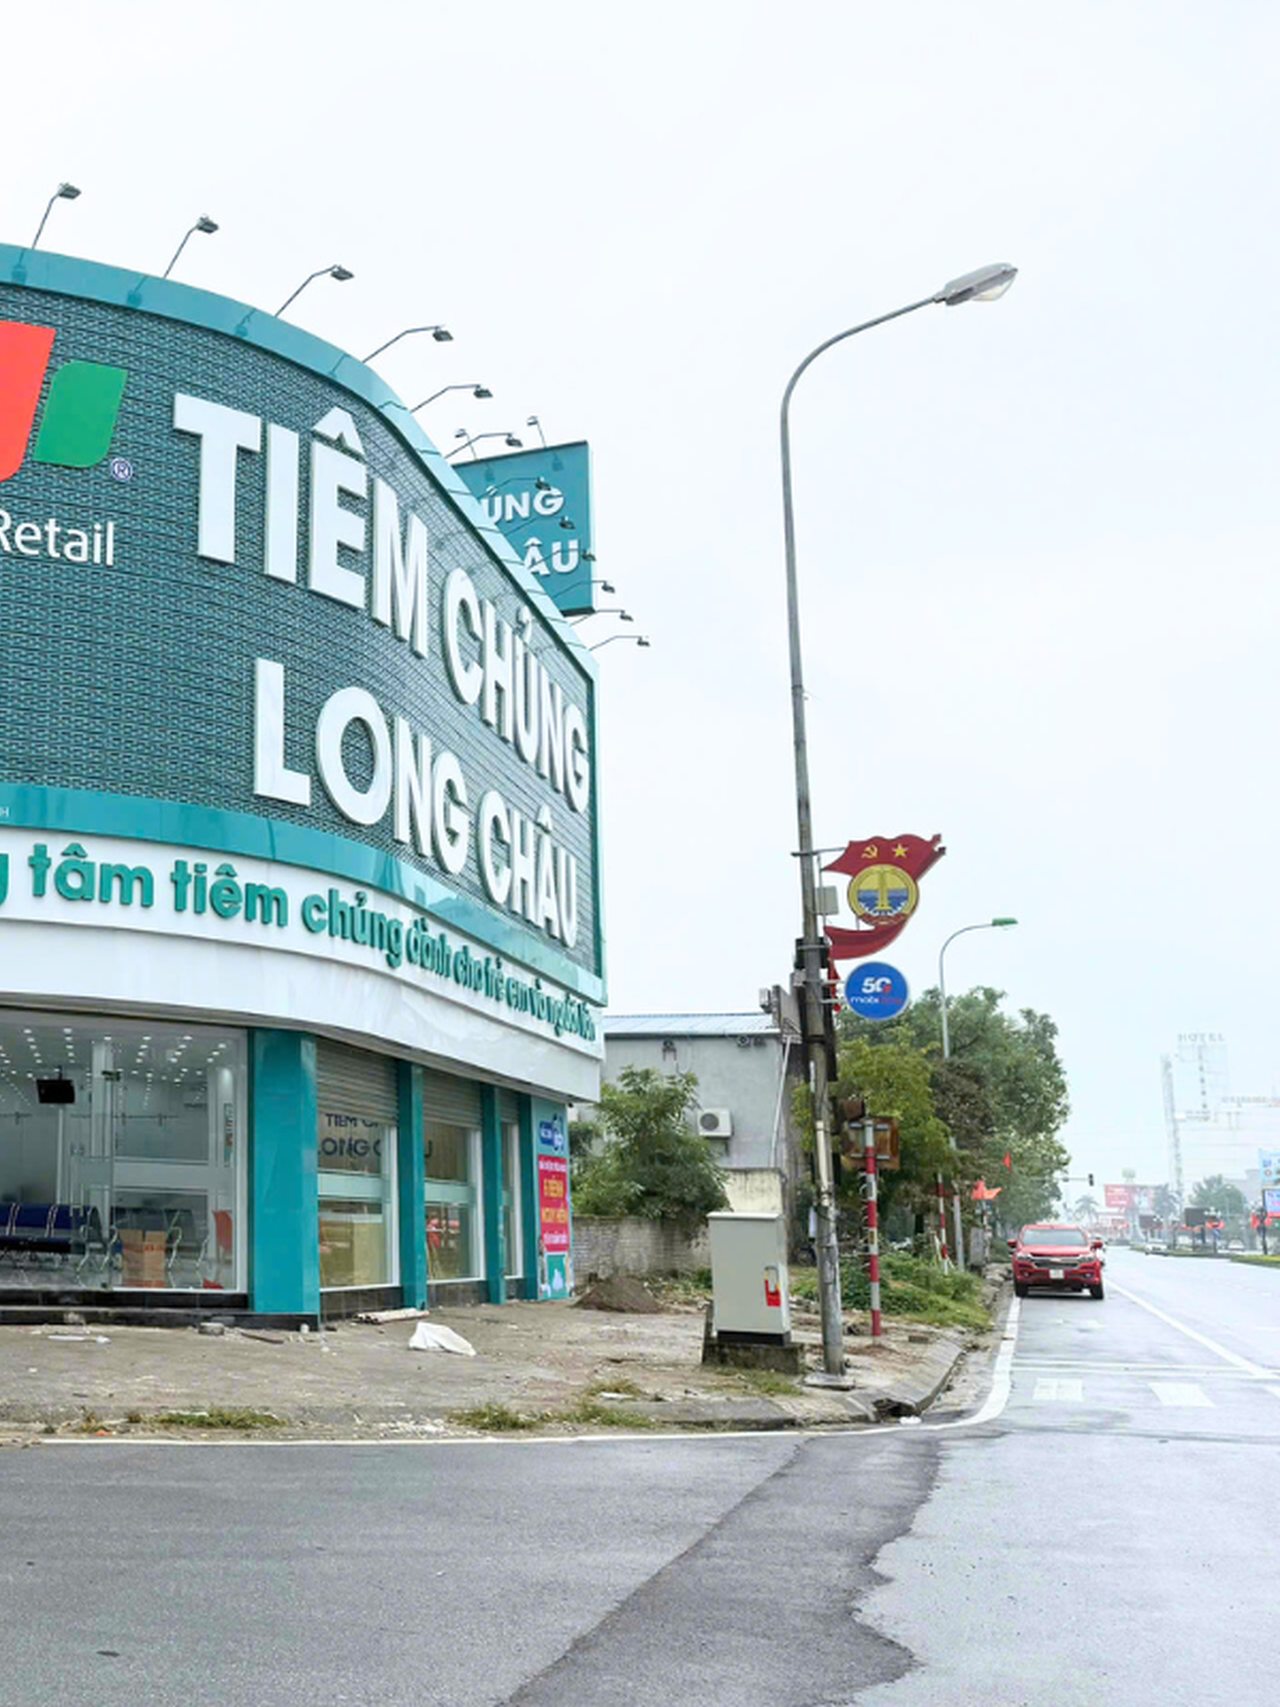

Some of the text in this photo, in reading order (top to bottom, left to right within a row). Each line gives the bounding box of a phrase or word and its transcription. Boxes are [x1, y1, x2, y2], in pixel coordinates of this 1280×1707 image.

[173, 392, 590, 815] TIÊM CHỦNG
[28, 842, 154, 908] tâm
[170, 859, 289, 928] tiêm
[301, 888, 404, 970] chủng
[405, 917, 452, 979] dành
[453, 945, 483, 991] cho
[484, 956, 505, 1001] trẻ
[505, 976, 528, 1013] em
[253, 657, 578, 949] LONG CHÂU
